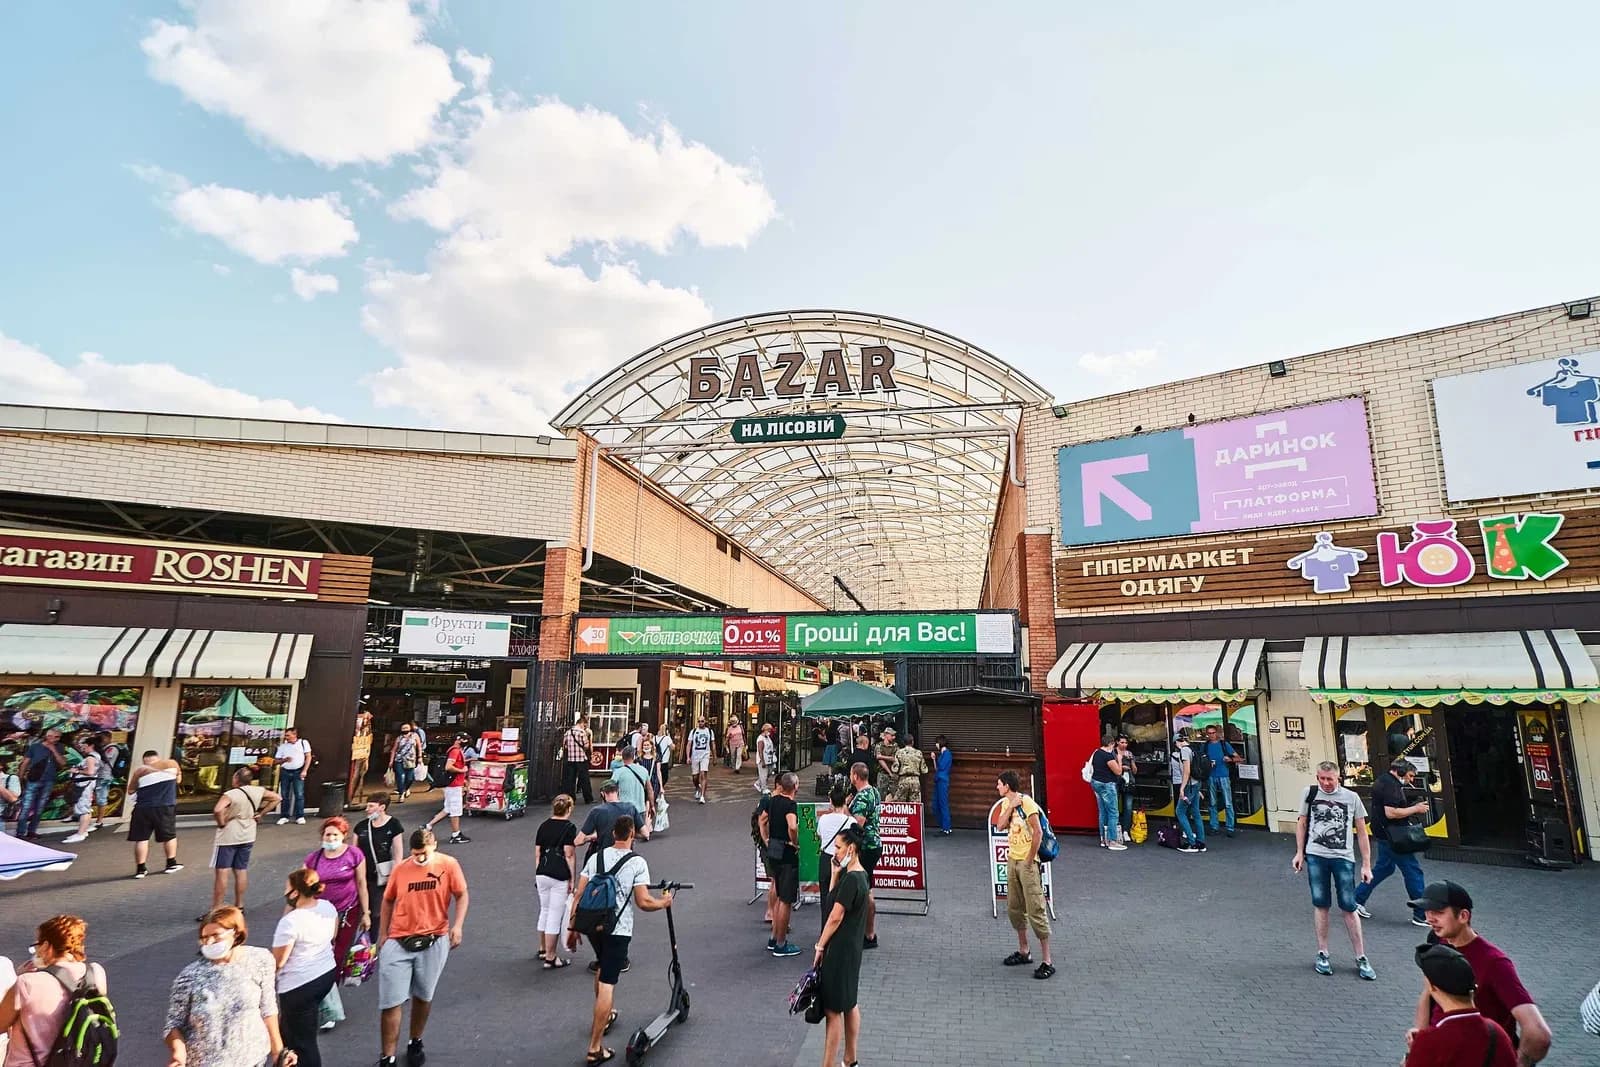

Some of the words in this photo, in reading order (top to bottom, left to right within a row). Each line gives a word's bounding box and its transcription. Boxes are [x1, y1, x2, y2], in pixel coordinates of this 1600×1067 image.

[741, 423, 763, 437] НА
[766, 417, 835, 436] ЛІСОВІЙ
[1215, 431, 1337, 467] ДАРИНОК
[1223, 487, 1337, 510] ПЛАТФОРМА
[0, 546, 135, 573] агазин
[151, 549, 311, 587] ROSHEN
[1082, 548, 1254, 577] ГІПЕРМАРКЕТ
[1120, 575, 1206, 597] ОДЯГУ
[431, 615, 482, 632] Фрукти
[435, 631, 476, 645] Овочі
[591, 629, 605, 639] 30
[642, 630, 720, 645] ГОТІВОЧКА
[794, 622, 859, 648] Гроші
[865, 626, 910, 646] для
[917, 622, 967, 642] Вас!
[880, 804, 917, 815] РФЮМЫ
[882, 843, 906, 856] ДУХИ
[876, 857, 883, 867] А
[884, 856, 918, 868] РАЗЛИВ
[407, 880, 437, 893] PUMA
[874, 878, 915, 888] КОСМЕТИКА
